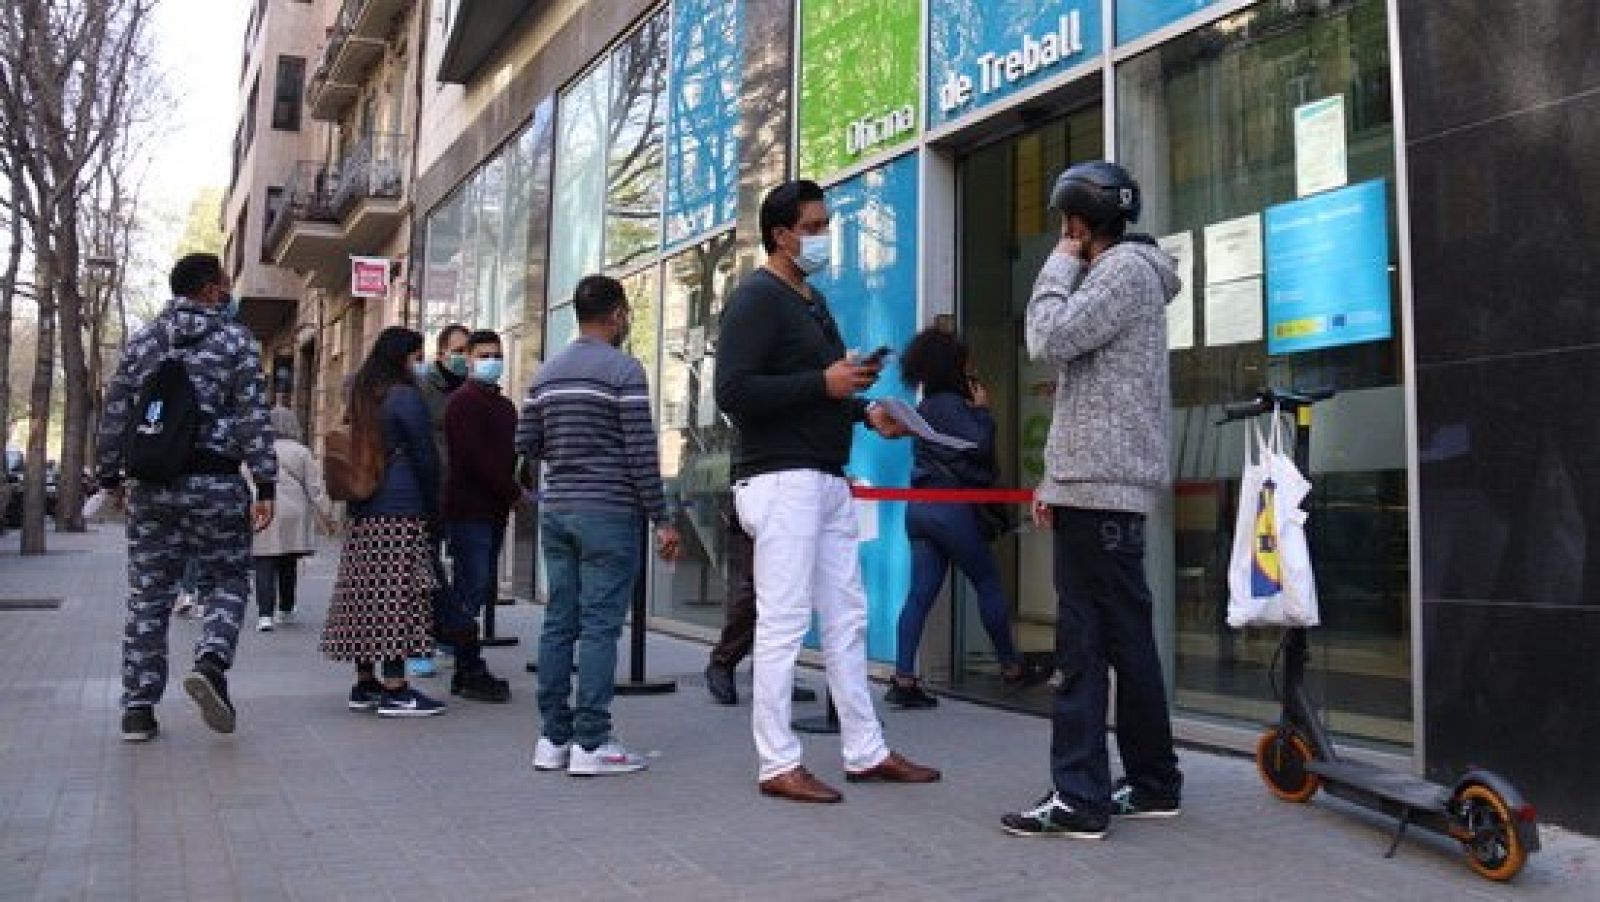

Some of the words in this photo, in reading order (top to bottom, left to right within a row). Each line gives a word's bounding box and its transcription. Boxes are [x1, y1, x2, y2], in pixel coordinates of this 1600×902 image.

[846, 105, 914, 155] Oficina
[940, 69, 973, 111] de
[977, 9, 1082, 93] Treball
